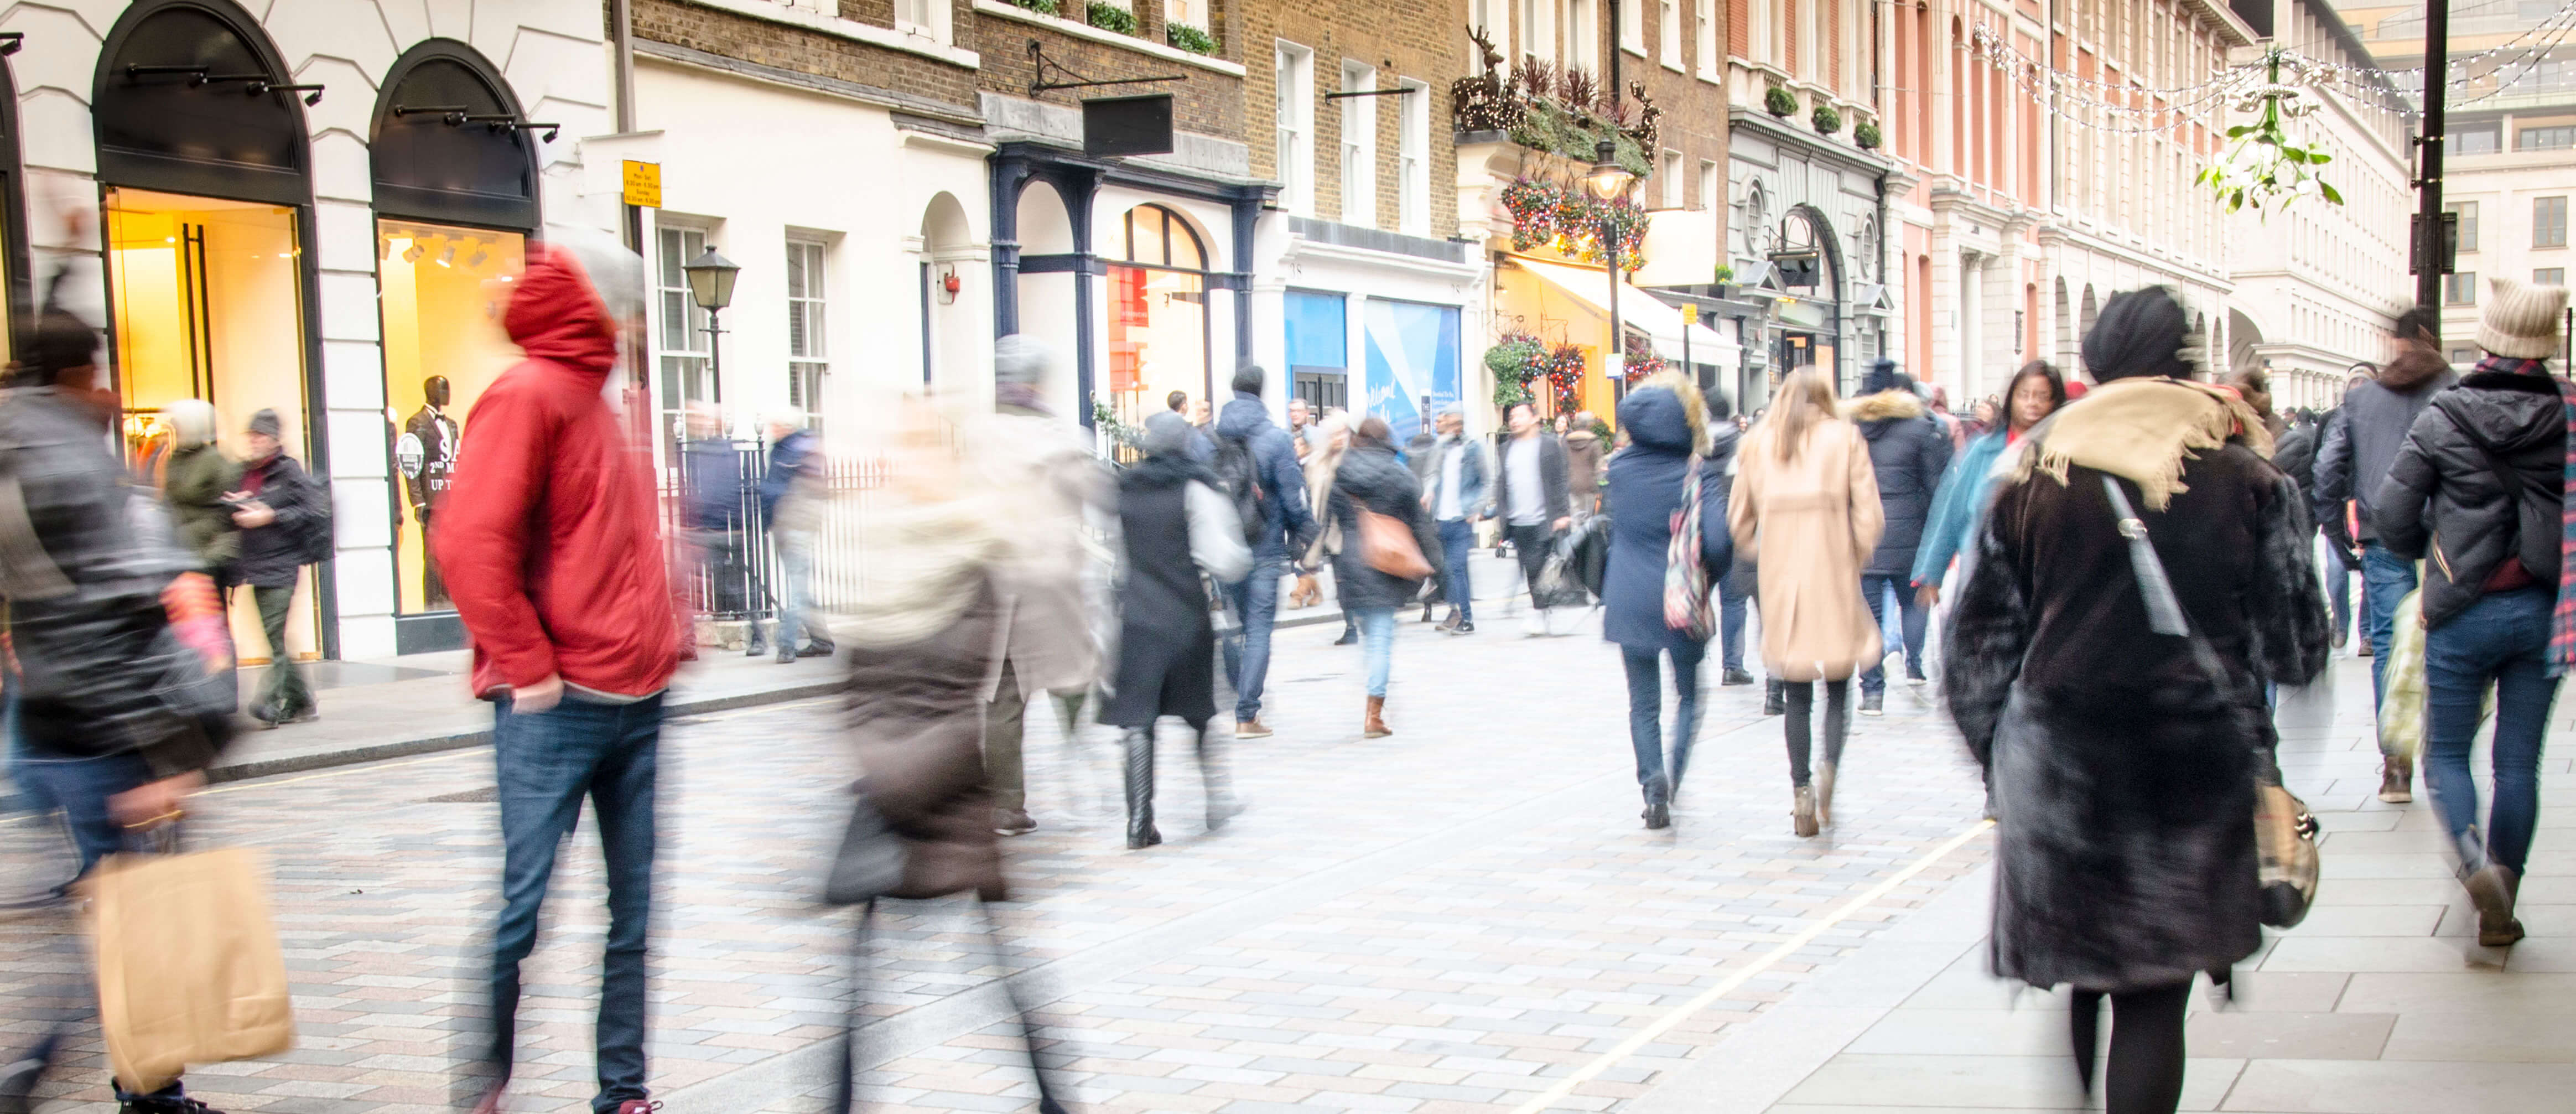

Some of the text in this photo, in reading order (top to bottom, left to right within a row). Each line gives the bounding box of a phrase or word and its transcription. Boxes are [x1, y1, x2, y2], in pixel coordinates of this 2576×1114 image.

[637, 189, 650, 197] Sunday
[439, 438, 460, 462] SA
[430, 461, 459, 474] 2ND M
[431, 479, 452, 491] UP T
